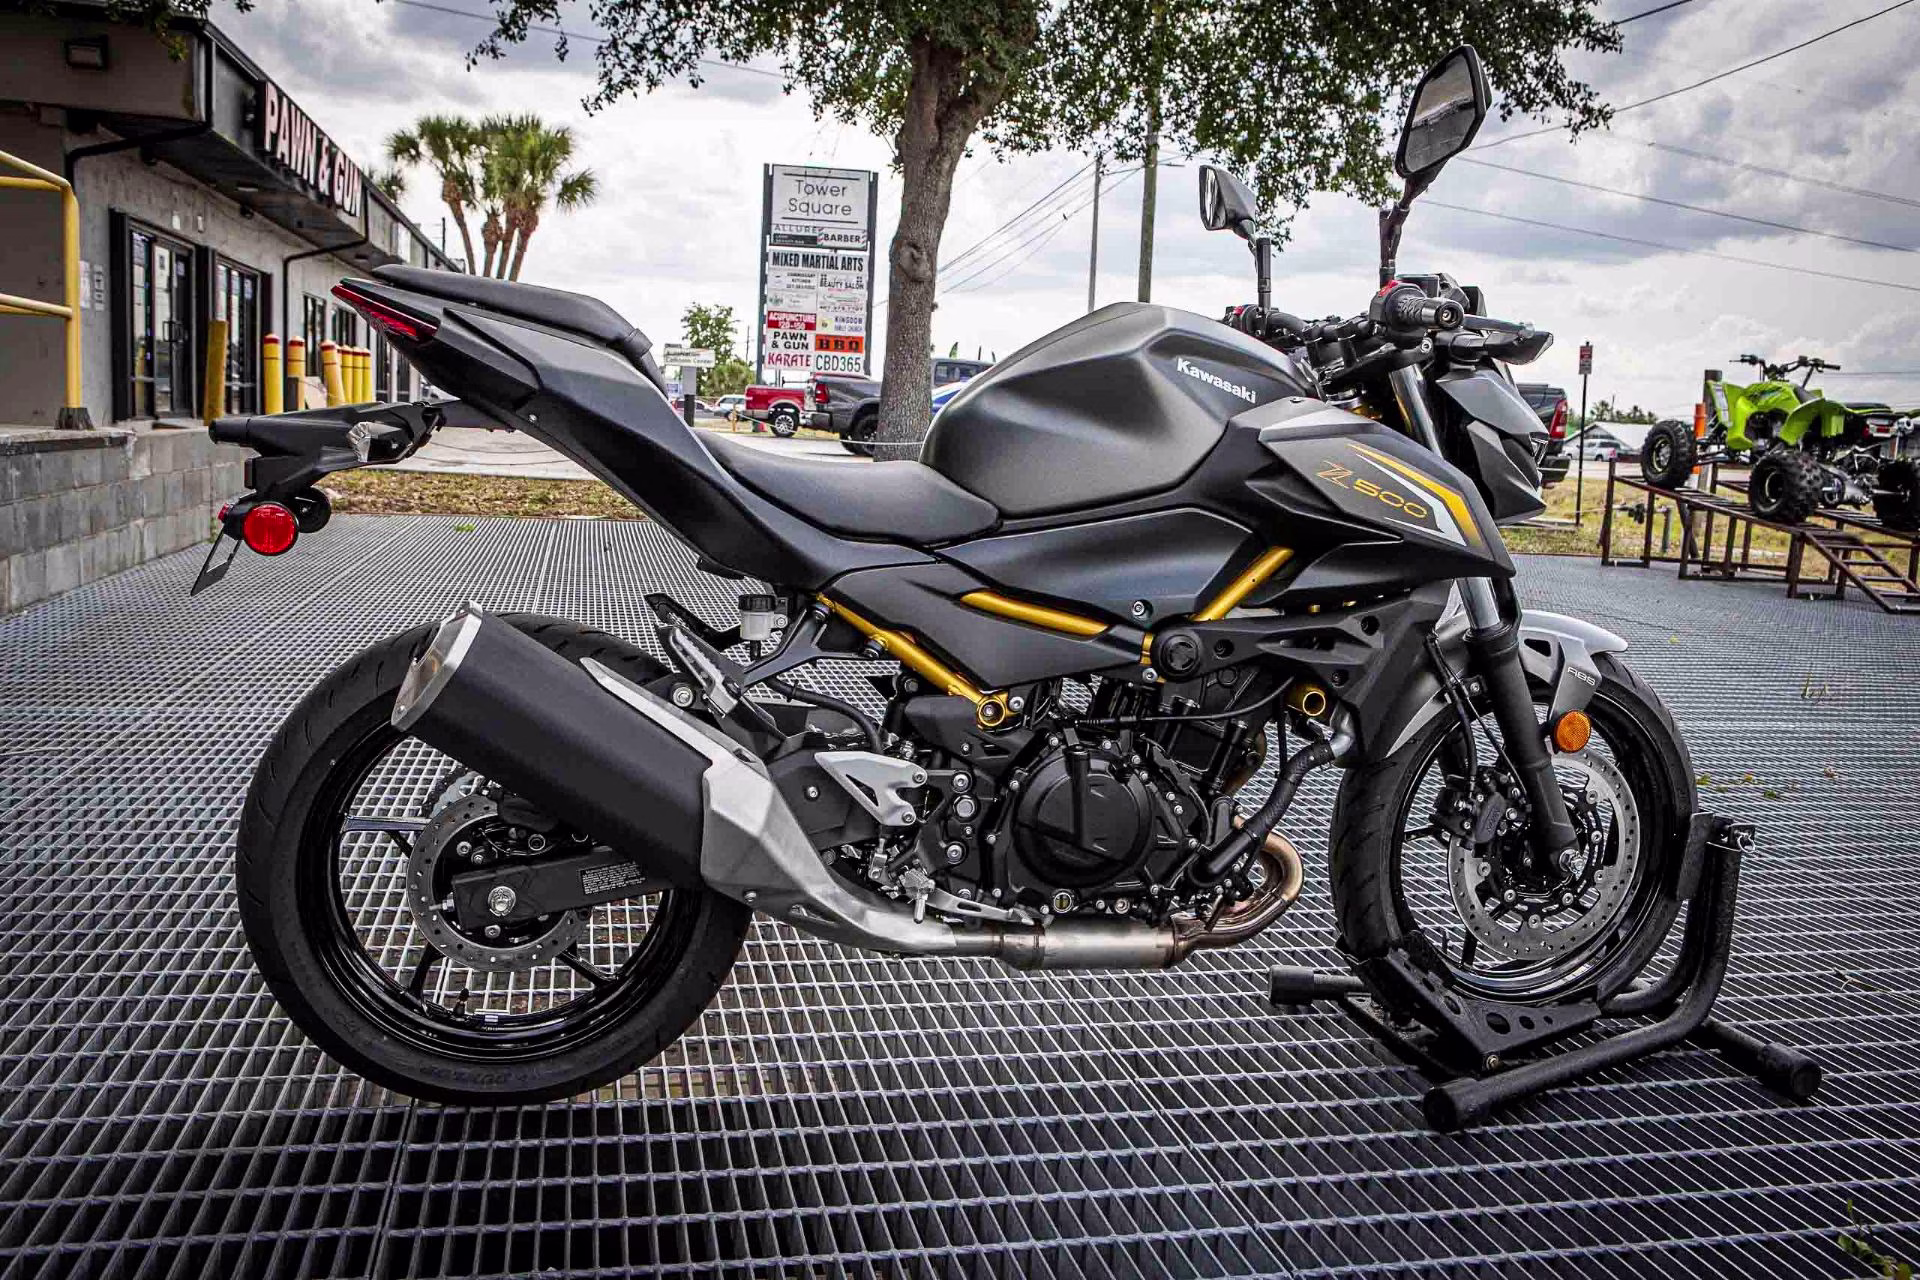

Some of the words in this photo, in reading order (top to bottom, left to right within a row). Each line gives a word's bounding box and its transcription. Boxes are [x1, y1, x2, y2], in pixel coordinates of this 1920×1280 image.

[264, 80, 317, 186] PAWN
[318, 135, 331, 196] &
[333, 149, 361, 217] GUN
[795, 179, 848, 197] Tower
[788, 197, 852, 216] Square
[774, 224, 817, 234] ALLURE
[823, 233, 861, 243] BARBER
[772, 252, 799, 267] MIXED
[801, 253, 839, 271] MARTIAL
[840, 257, 864, 272] ARTS
[819, 280, 842, 289] BEAUTY
[844, 281, 864, 290] SALON
[771, 340, 779, 349] &
[784, 341, 809, 350] GUN
[773, 331, 807, 341] PAWN
[767, 352, 812, 367] KARATE
[815, 354, 862, 373] CBD365
[1176, 357, 1257, 404] Kawasaki
[1567, 666, 1596, 686] ABS
